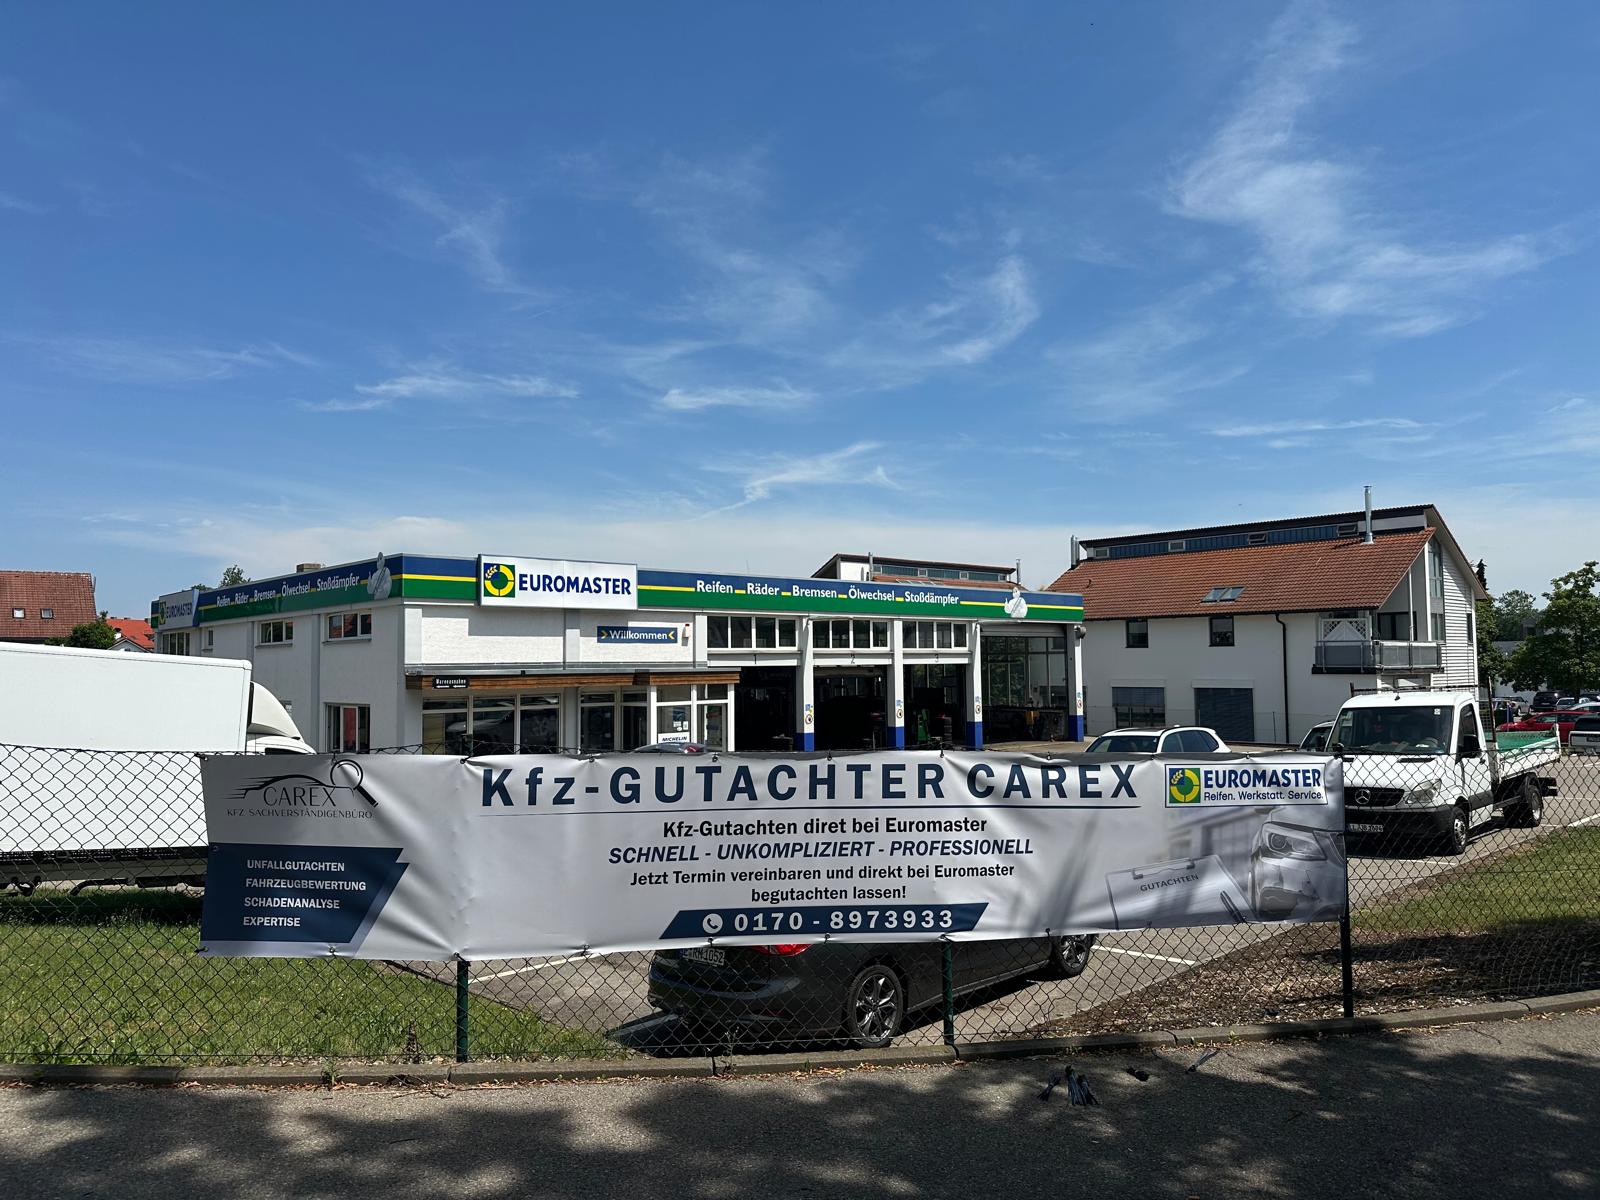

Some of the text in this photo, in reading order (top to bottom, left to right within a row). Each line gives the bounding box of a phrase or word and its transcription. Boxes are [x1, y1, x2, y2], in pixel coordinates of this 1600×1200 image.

[216, 574, 360, 608] Reifen Räder Bremsen Ölwechsel Stoßdämpfer
[519, 574, 632, 595] EUROMASTER
[696, 580, 959, 606] Reifen Räder Bremsen Ölwechsel Stoßdämpfer
[166, 602, 192, 619] EUROMASTER
[610, 630, 668, 641] Willkommen
[482, 764, 1137, 807] Kfz-GUTACHTER CAREX
[1204, 768, 1321, 789] EUROMASTER
[263, 786, 336, 807] CAREX
[1204, 790, 1324, 801] Reifen. Werkstatt. Service.
[227, 808, 373, 819] KFZ SACHVERSTÄNDIGENBÜRO
[663, 817, 987, 838] Kfz-Gutachten diret bei Euromaster
[609, 846, 700, 864] SCHNELL
[717, 840, 875, 860] UNKOMPLIZIERT
[889, 839, 1034, 857] PROFESSIONELL
[247, 859, 345, 872] UNFALLGUTACHTEN
[630, 864, 1015, 886] Jetzt Termin vereinbaren und direkt bei Euromaster
[245, 878, 367, 891] FAHRZEUGBEWERTUNG
[1140, 874, 1199, 892] GUTACHTEN
[244, 897, 340, 909] SCHADENANALYSE
[751, 885, 906, 904] begutachten lassen!
[243, 916, 301, 927] EXPERTISE
[734, 911, 803, 931] 0170
[830, 909, 953, 929] 8973933
